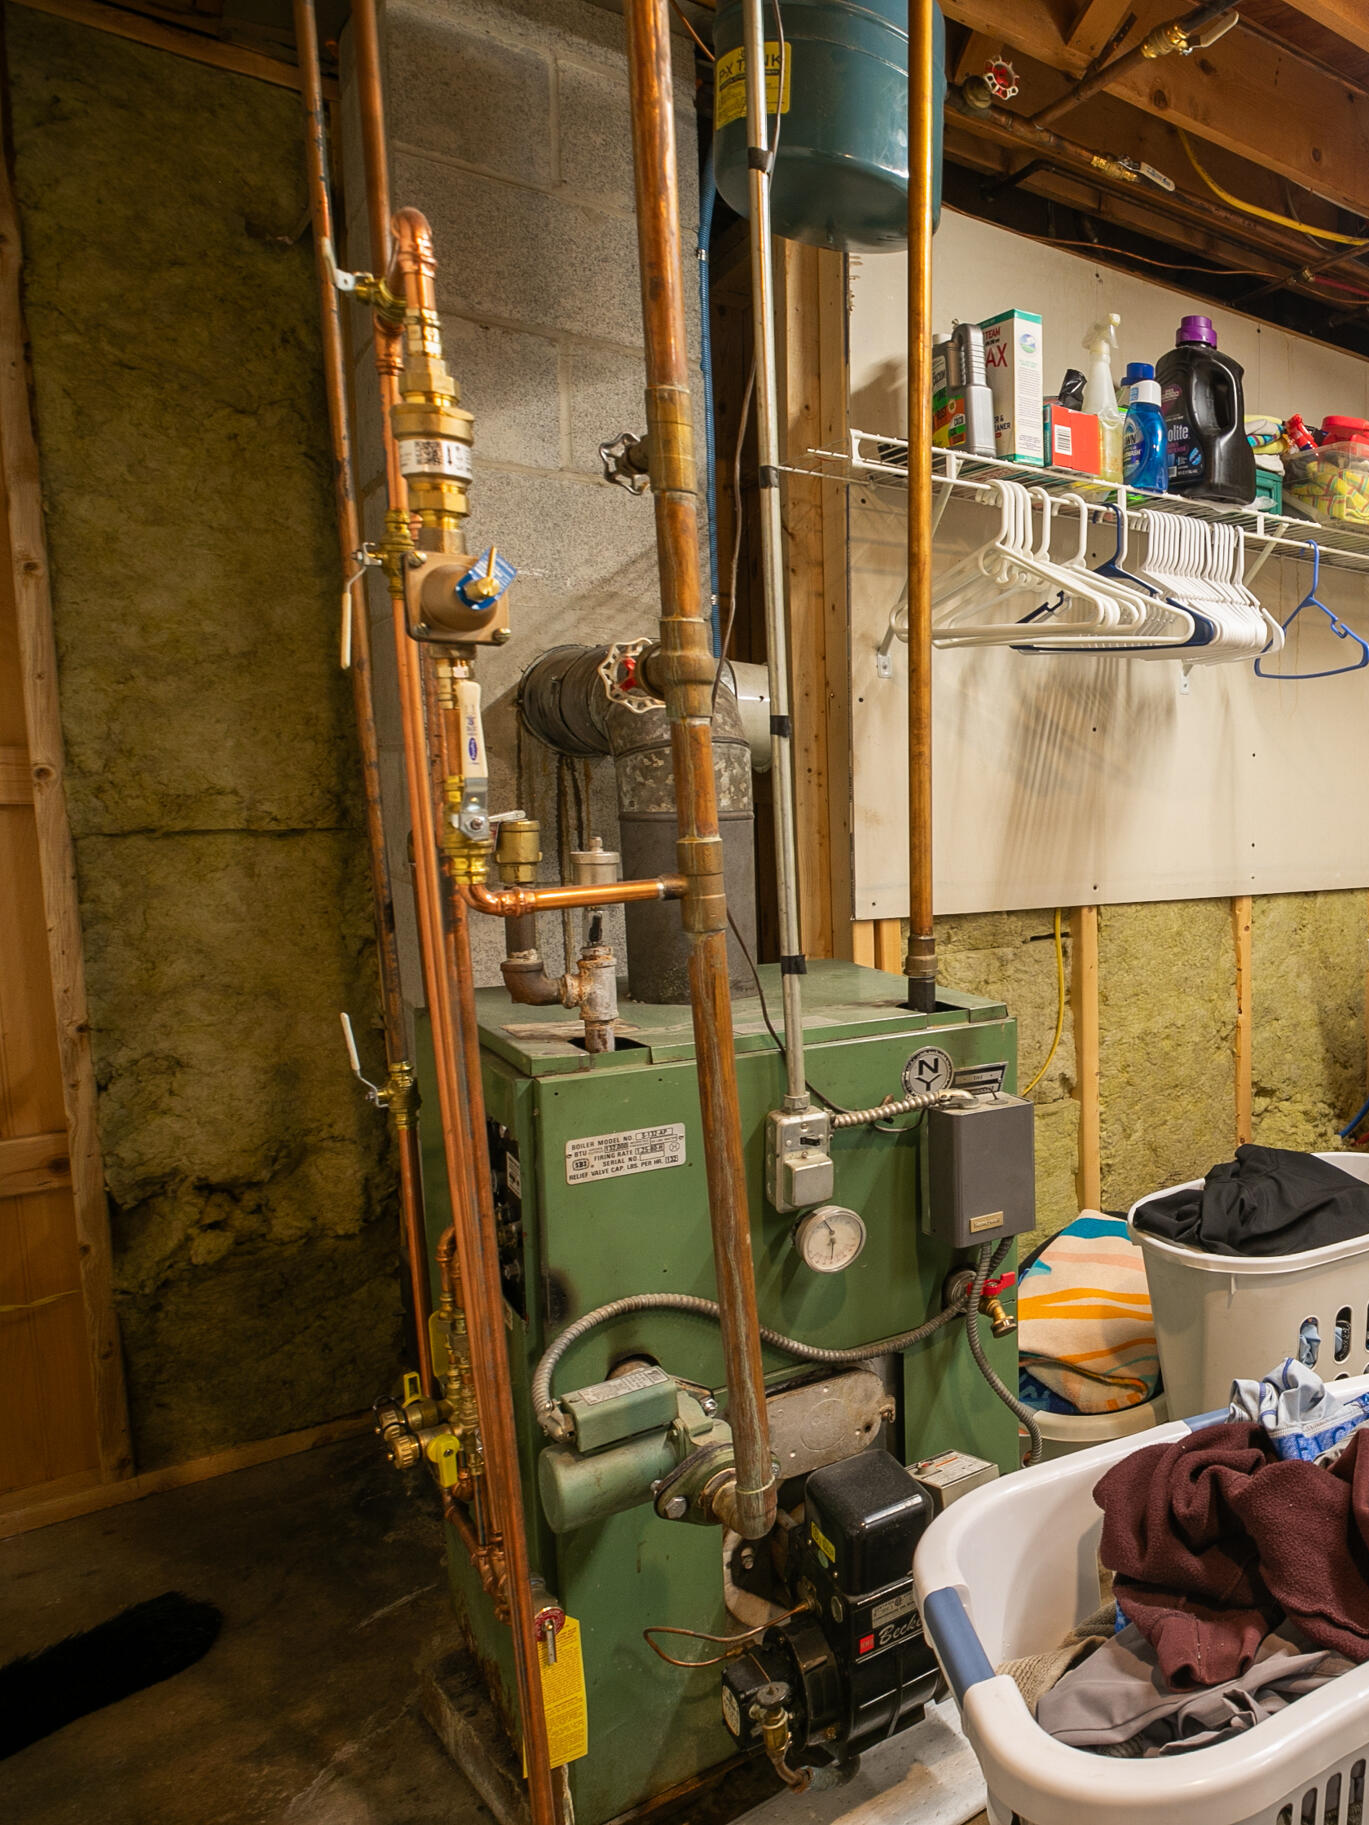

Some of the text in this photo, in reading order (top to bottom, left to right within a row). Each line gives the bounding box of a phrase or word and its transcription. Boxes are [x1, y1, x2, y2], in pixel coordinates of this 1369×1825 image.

[985, 327, 1000, 340] TEAM
[985, 342, 1008, 368] AX
[1167, 425, 1189, 442] olite
[572, 1141, 595, 1151] BOILER
[598, 1137, 620, 1146] MODEL
[574, 1150, 588, 1159] BTU
[594, 1151, 616, 1161] FIRING
[617, 1149, 634, 1158] RATE
[602, 1158, 625, 1167] SERIAL
[568, 1172, 589, 1181] RELIEF
[591, 1168, 609, 1177] VALVE
